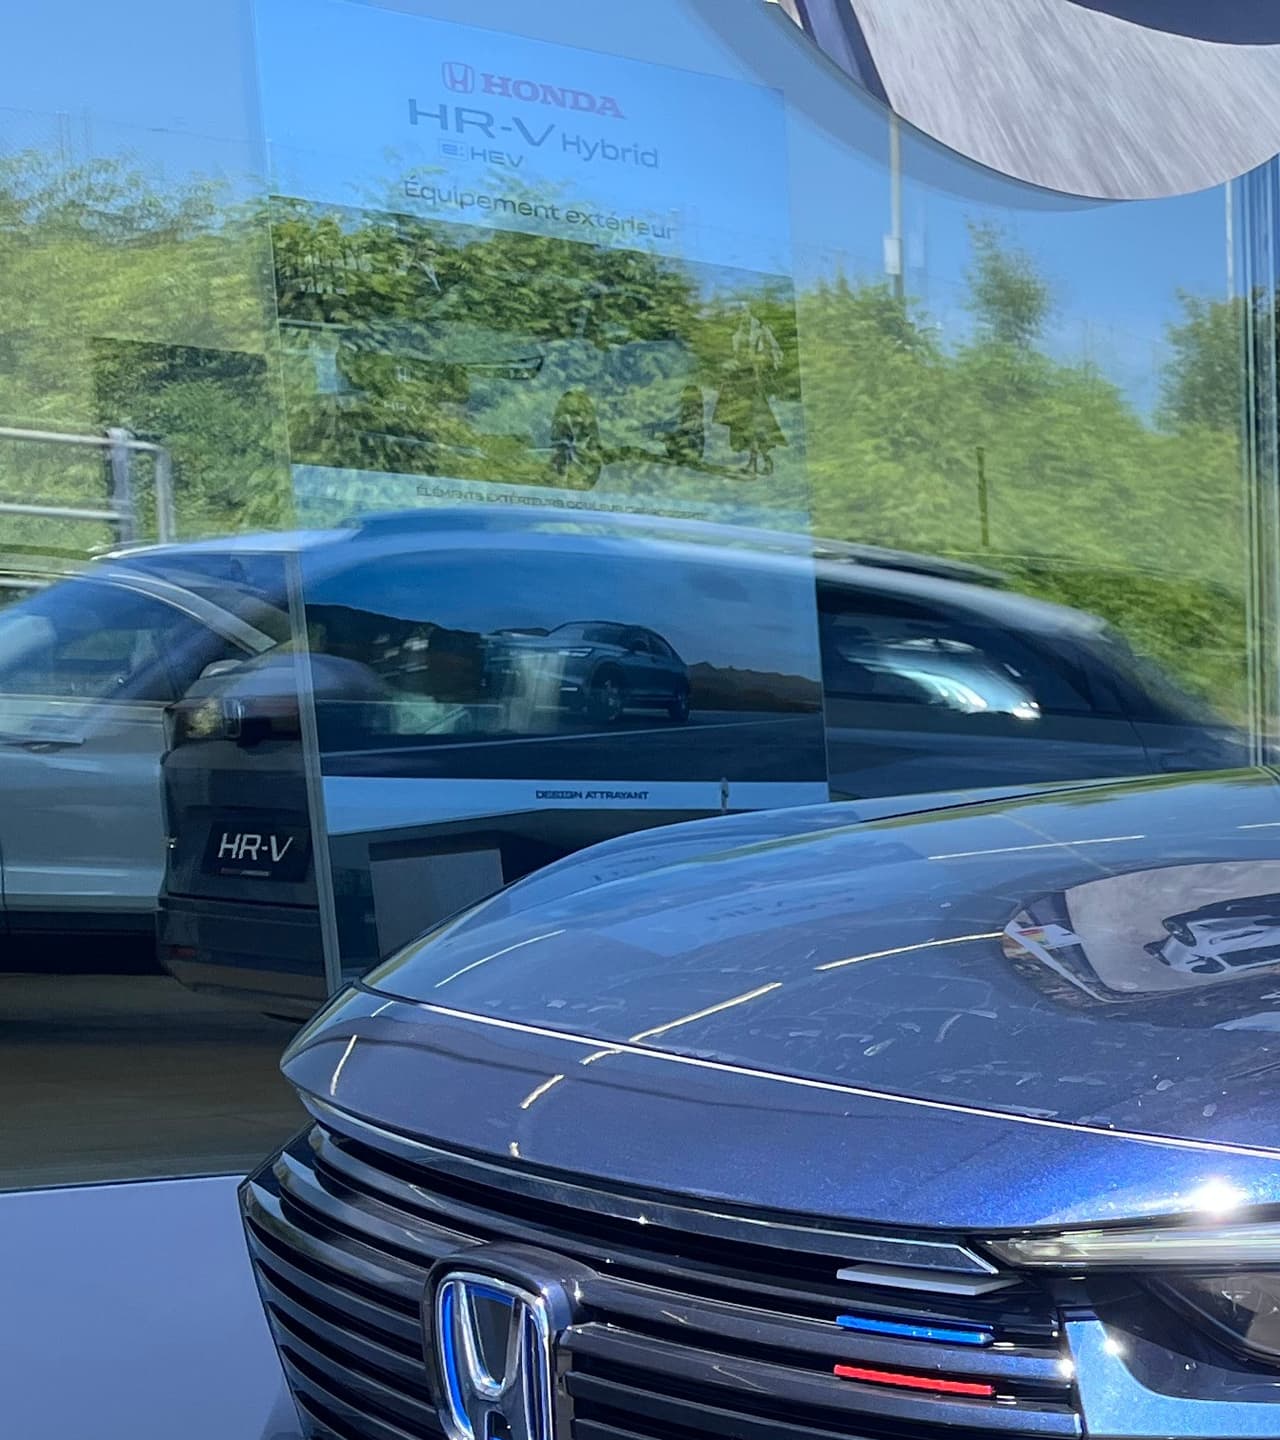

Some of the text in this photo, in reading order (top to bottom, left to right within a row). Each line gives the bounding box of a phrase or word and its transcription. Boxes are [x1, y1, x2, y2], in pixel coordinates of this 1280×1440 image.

[480, 72, 627, 120] HONDA
[407, 98, 659, 169] HR-V Hybrid
[404, 176, 677, 240] Équipement extérieur
[584, 790, 650, 800] ATTRAYANT
[217, 832, 294, 863] HR-V
